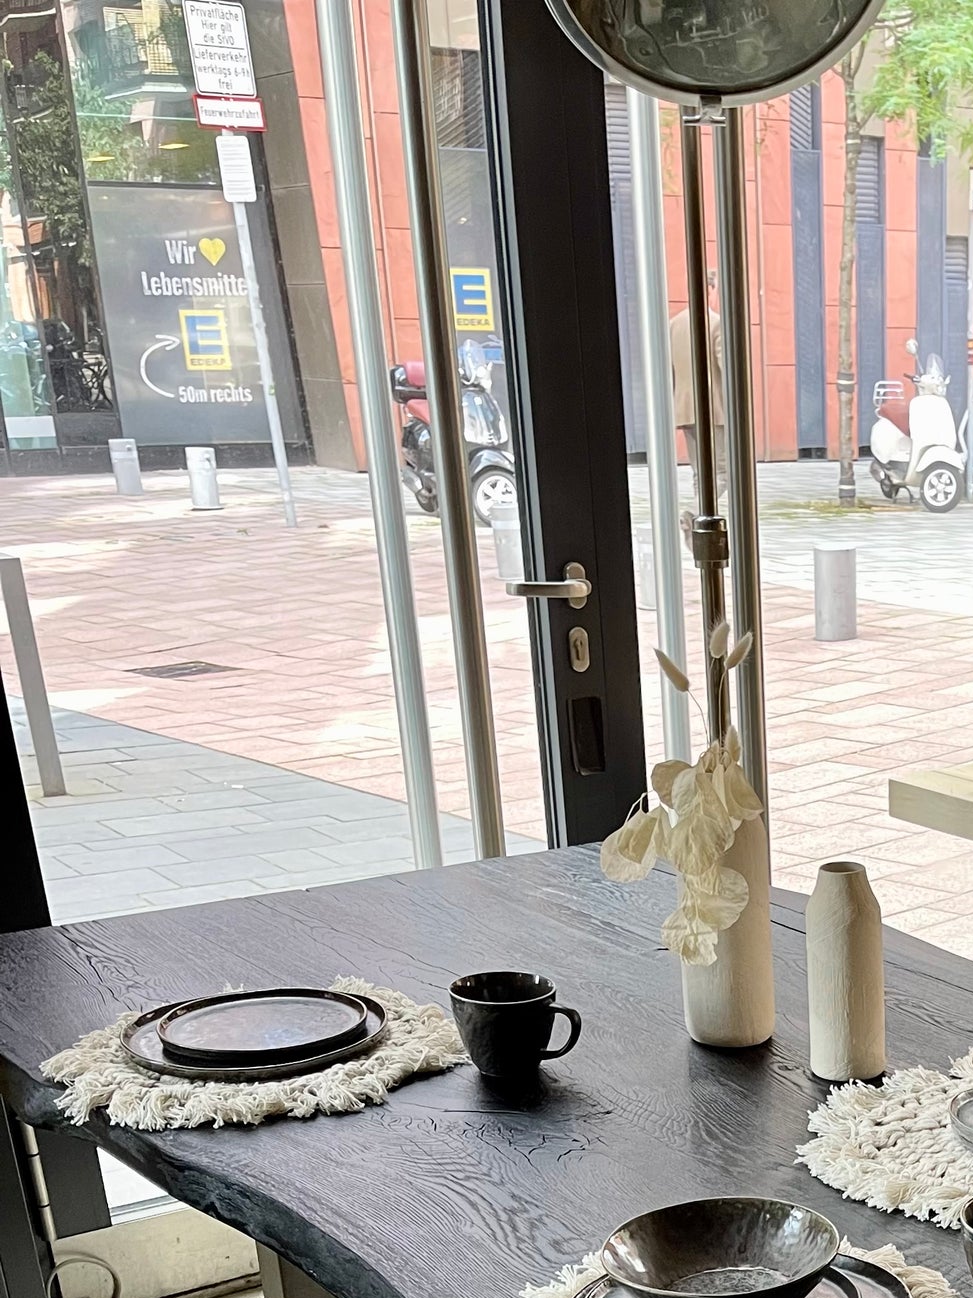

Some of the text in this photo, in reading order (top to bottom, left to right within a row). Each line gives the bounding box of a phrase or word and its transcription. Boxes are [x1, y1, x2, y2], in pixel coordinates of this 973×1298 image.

[190, 5, 239, 21] Privatfläche
[201, 20, 232, 34] Hier gilt
[203, 34, 214, 43] die
[192, 47, 247, 62] Lieferverkehr
[198, 64, 231, 78] werktags
[219, 78, 233, 90] frei
[200, 106, 260, 119] Feuerwehrzufahrt
[165, 239, 197, 265] Wir
[141, 271, 249, 296] Lebensmitte
[457, 318, 490, 326] EDEKA
[178, 386, 253, 403] 50m rechts
